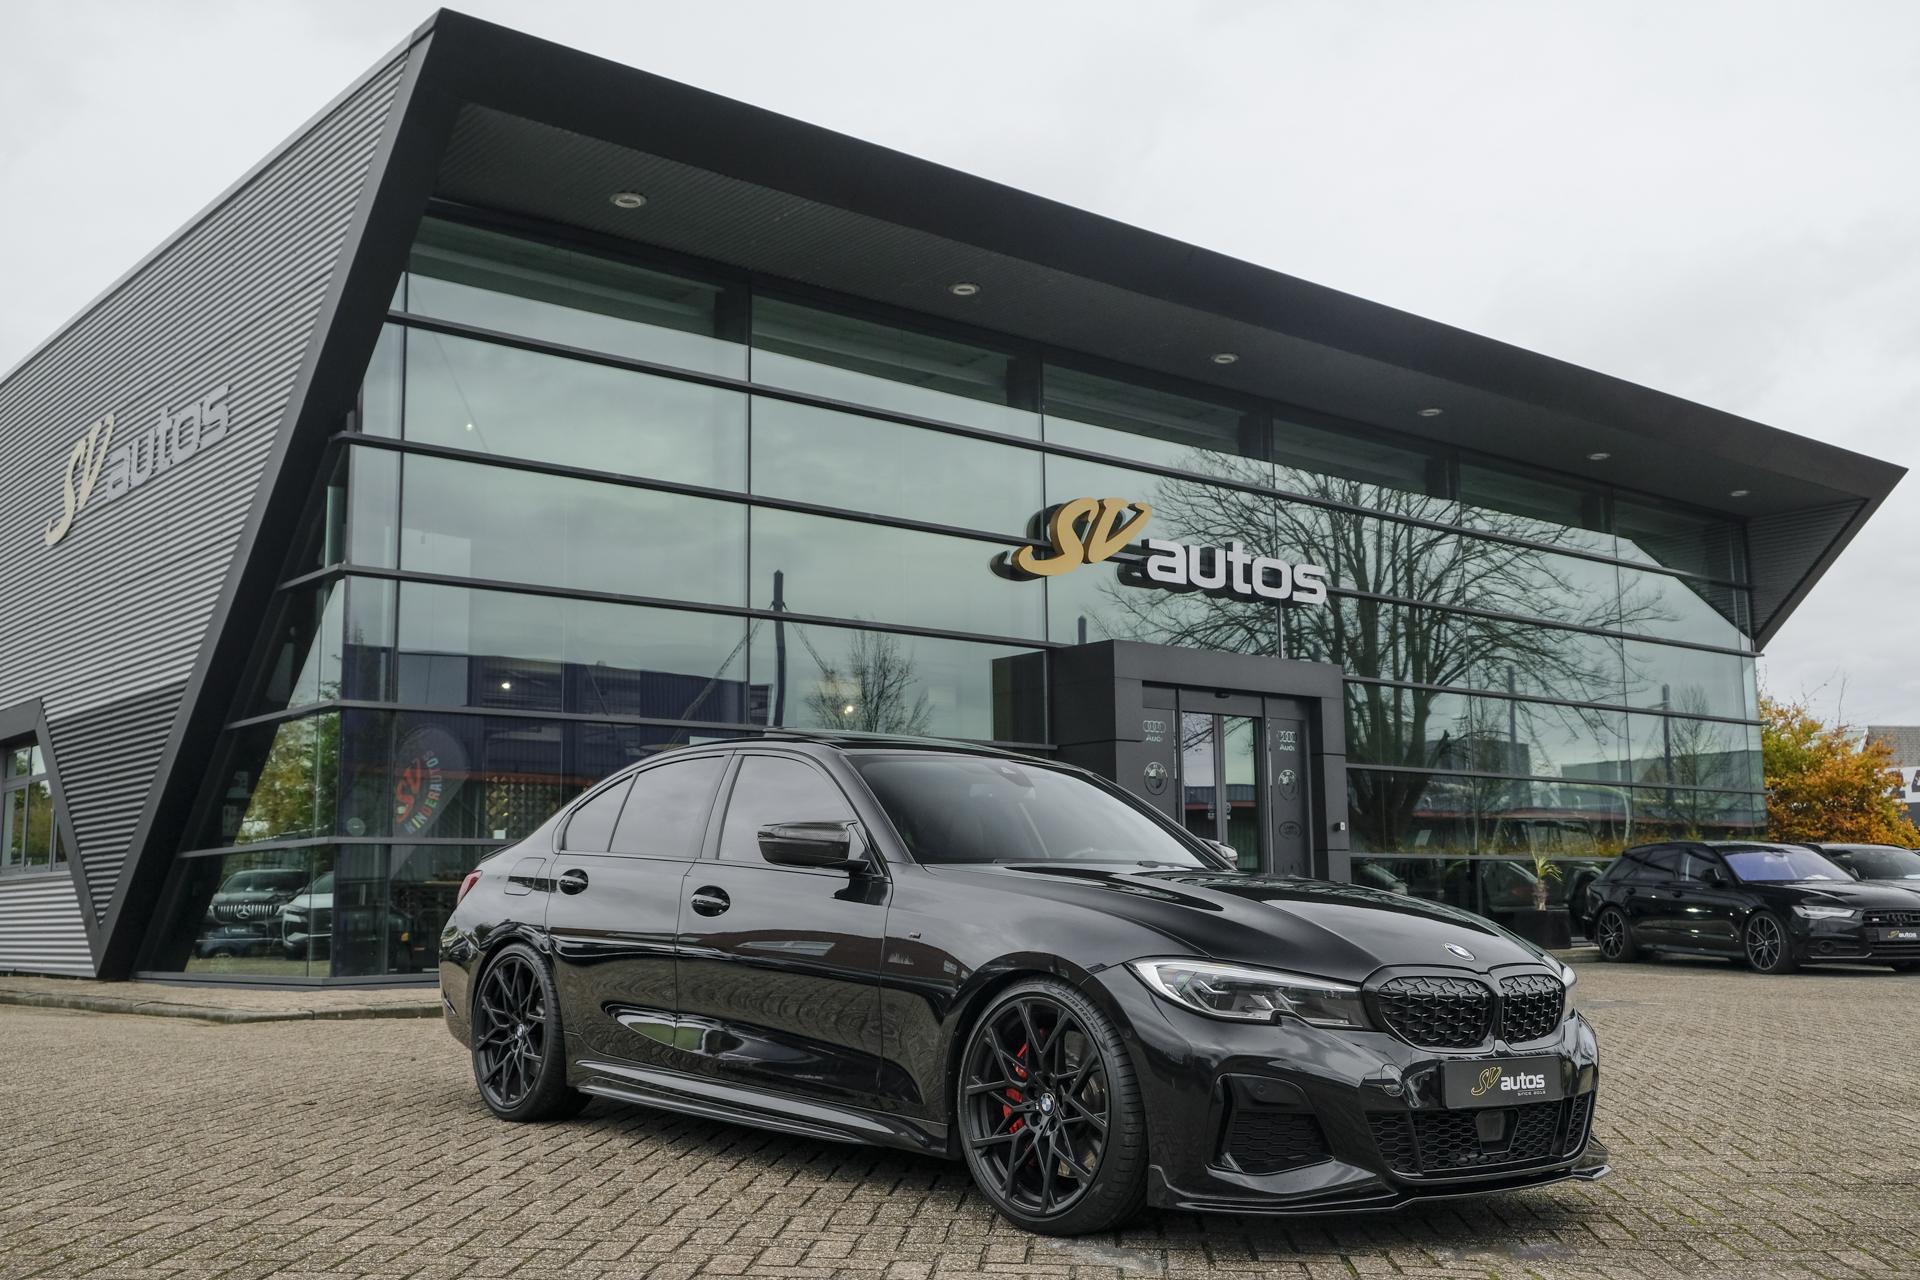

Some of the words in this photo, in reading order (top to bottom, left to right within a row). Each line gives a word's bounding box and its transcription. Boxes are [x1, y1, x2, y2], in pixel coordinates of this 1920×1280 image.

[106, 383, 230, 501] autos
[1012, 497, 1153, 577] SV
[1145, 538, 1328, 605] autos
[1471, 1067, 1502, 1096] SV
[1500, 1072, 1546, 1091] autos
